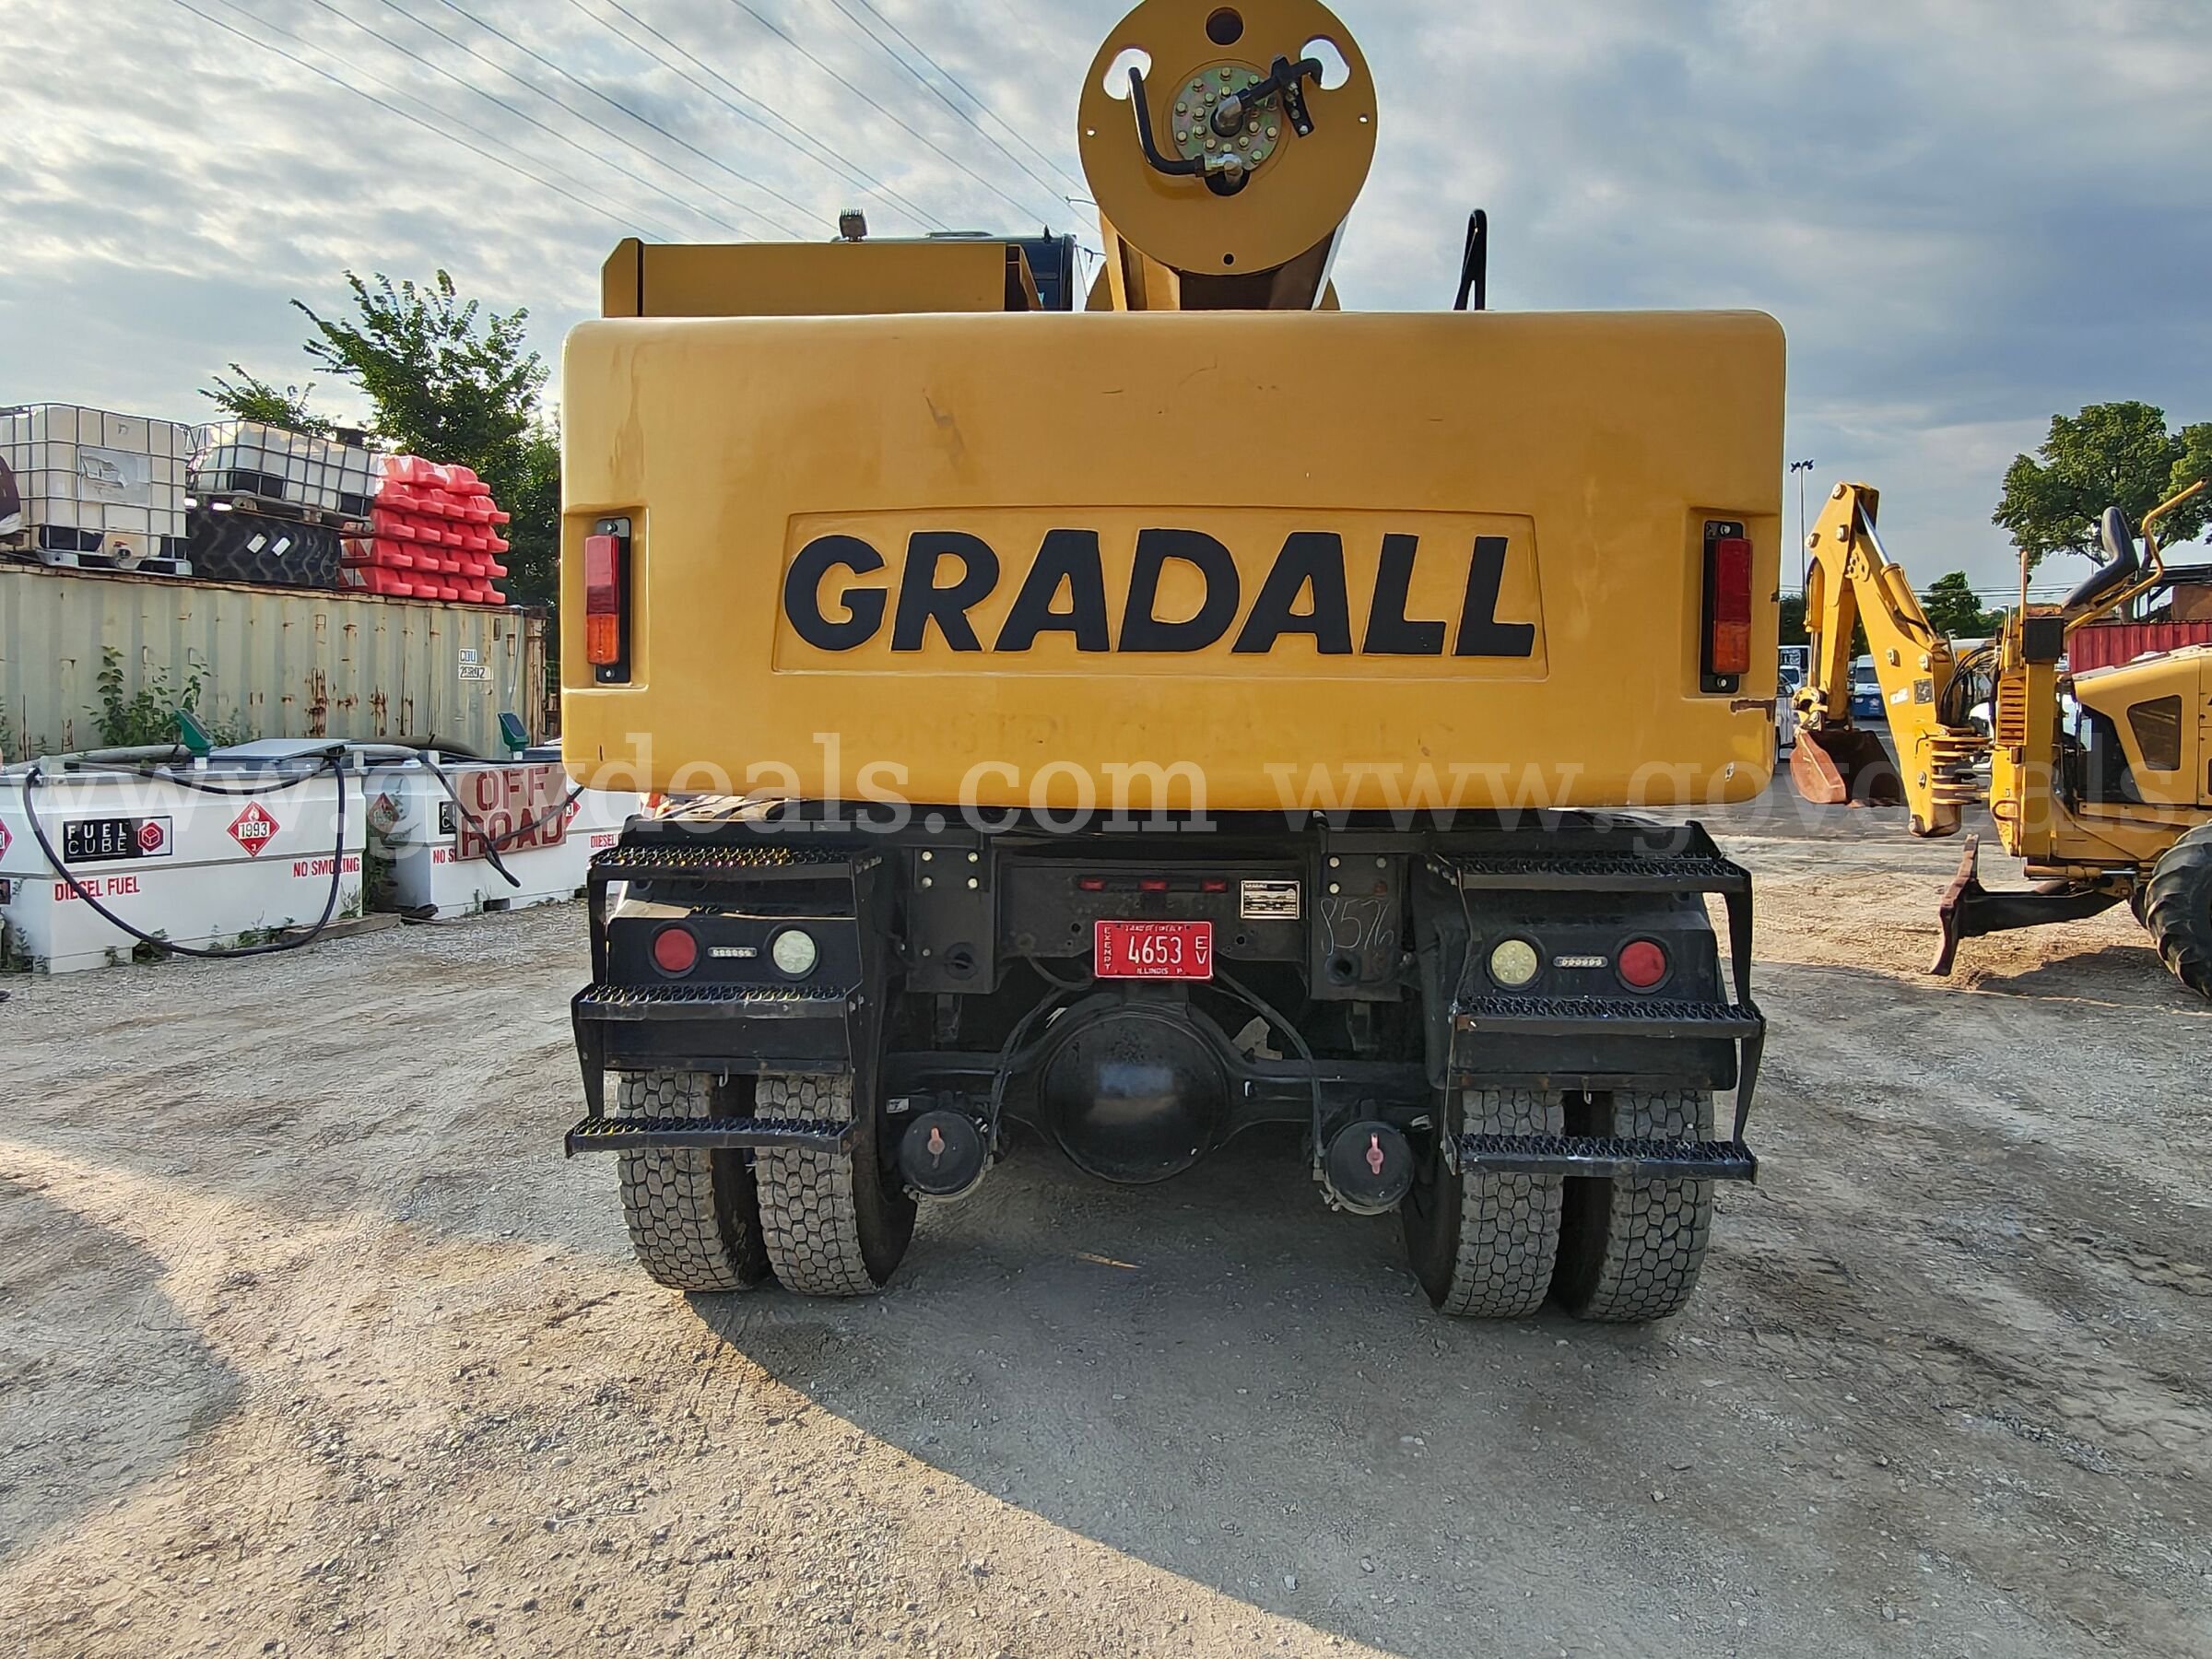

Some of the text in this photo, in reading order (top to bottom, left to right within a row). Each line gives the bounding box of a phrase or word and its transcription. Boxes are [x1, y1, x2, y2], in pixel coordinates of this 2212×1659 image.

[784, 528, 1535, 656] GRADALL
[476, 766, 550, 812] OFF
[67, 823, 127, 840] FUEL
[240, 822, 268, 838] 1993
[461, 805, 565, 858] ROAD
[67, 837, 127, 854] CUBE
[293, 857, 360, 877] NO SMOING
[432, 849, 446, 865] NO
[108, 876, 140, 896] FUEL
[1127, 935, 1182, 964] 4653
